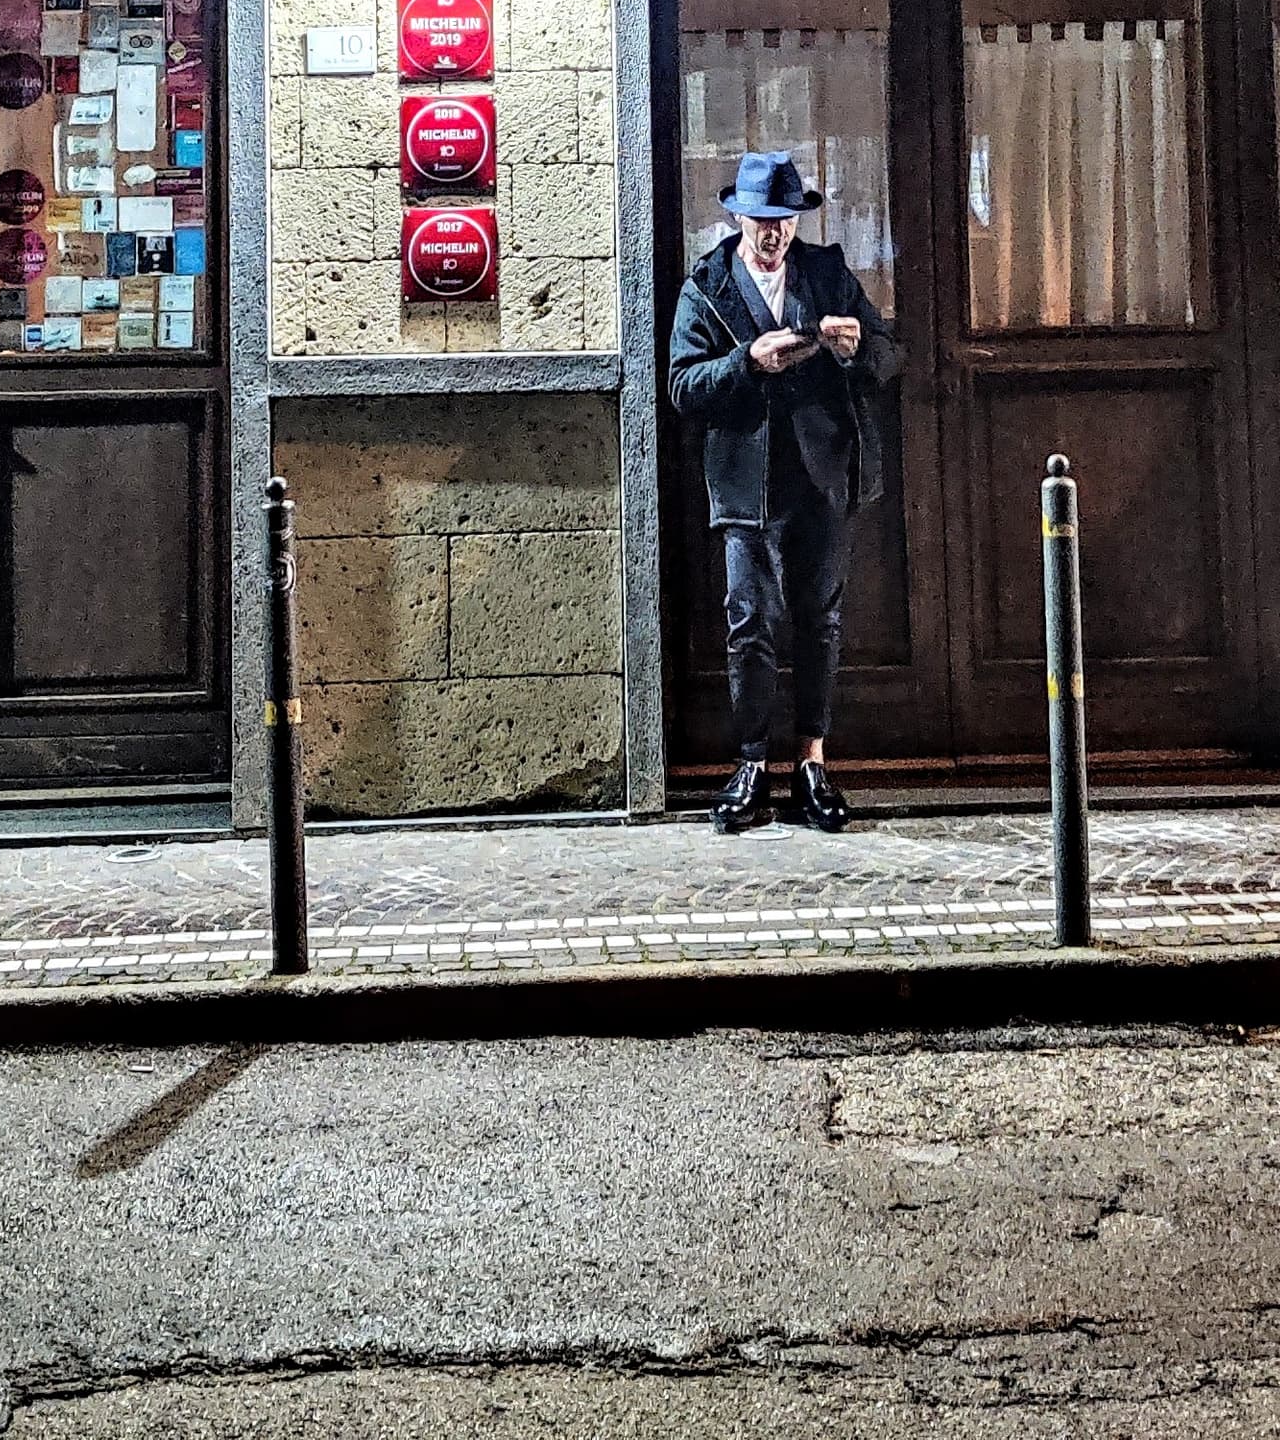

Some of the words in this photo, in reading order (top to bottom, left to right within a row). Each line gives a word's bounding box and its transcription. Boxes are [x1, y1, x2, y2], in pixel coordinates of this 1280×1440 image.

[410, 17, 481, 31] MICHELIN
[340, 35, 363, 55] 10
[430, 33, 462, 46] 2019
[419, 129, 476, 140] MICHELIN
[420, 242, 479, 254] MICHELIN
